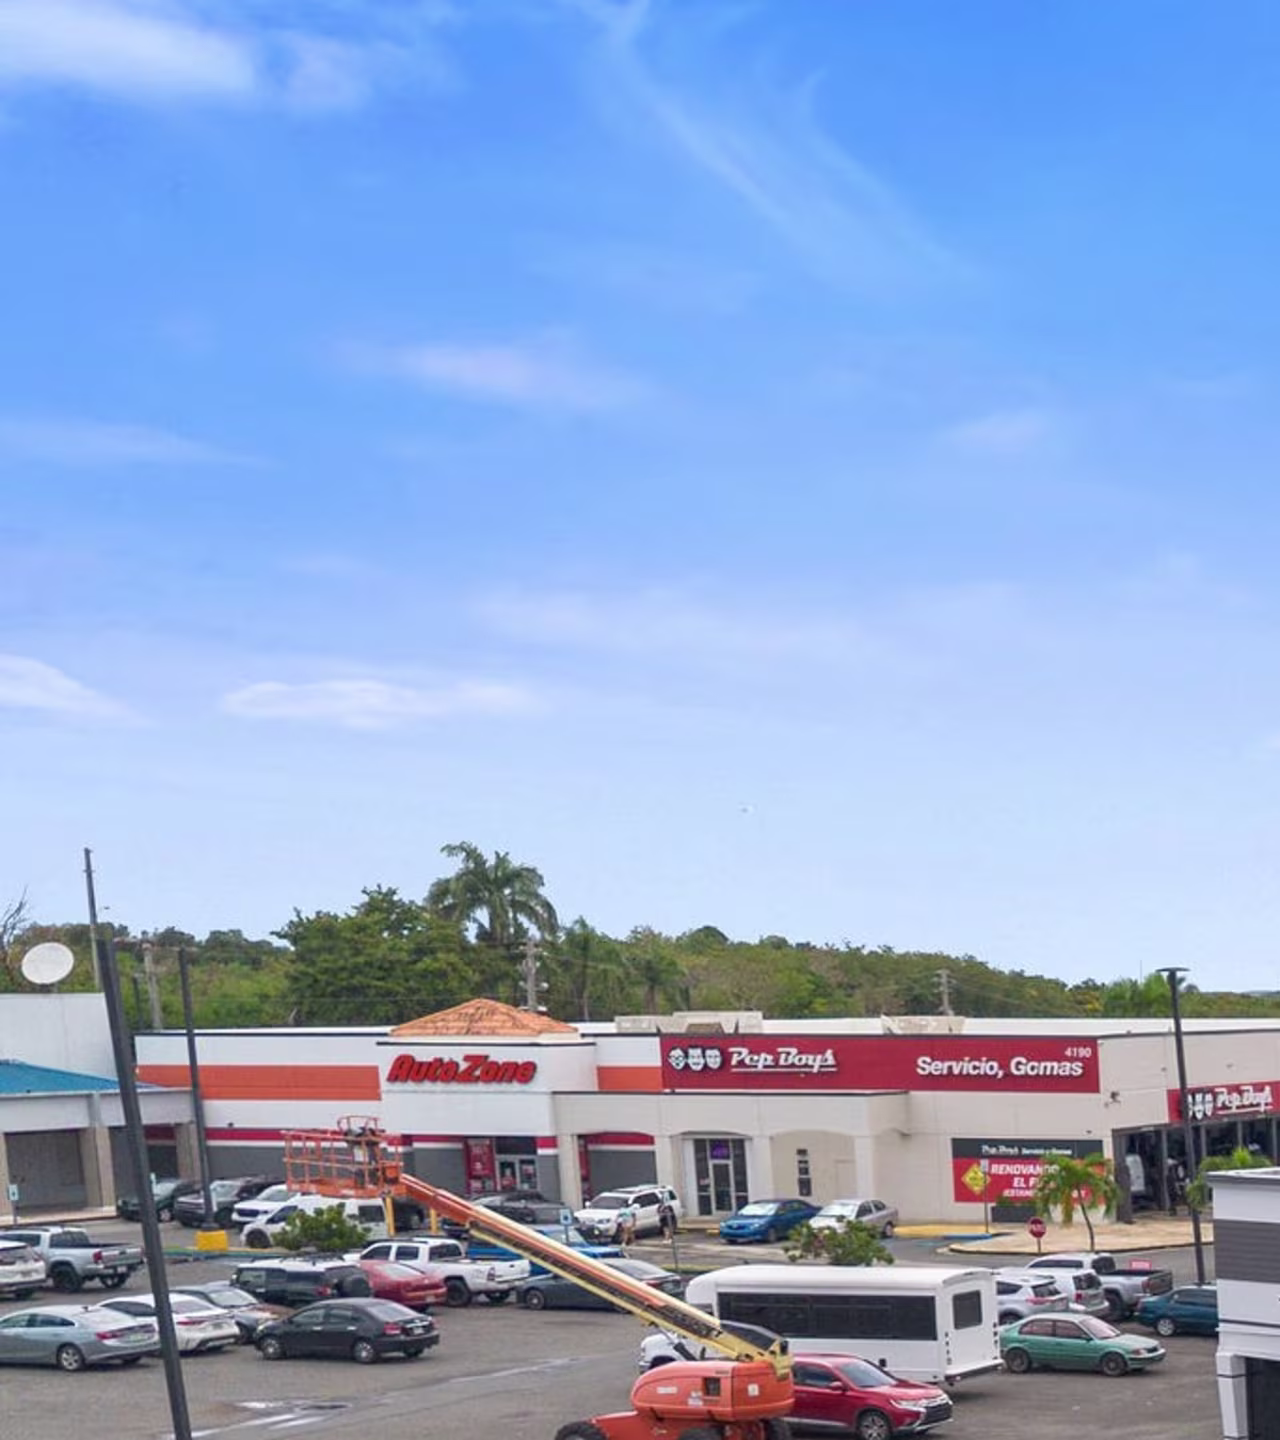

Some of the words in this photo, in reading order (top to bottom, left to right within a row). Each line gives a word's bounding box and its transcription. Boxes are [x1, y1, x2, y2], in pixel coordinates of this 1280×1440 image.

[728, 1048, 774, 1070] Pep
[777, 1048, 837, 1074] Boys
[1064, 1047, 1091, 1058] 4190
[386, 1054, 538, 1085] AutoZone
[916, 1057, 1004, 1079] Servicio,
[1010, 1057, 1083, 1076] Gomas
[1214, 1087, 1240, 1111] Pep
[1240, 1085, 1273, 1113] Boys
[1012, 1177, 1027, 1188] EL
